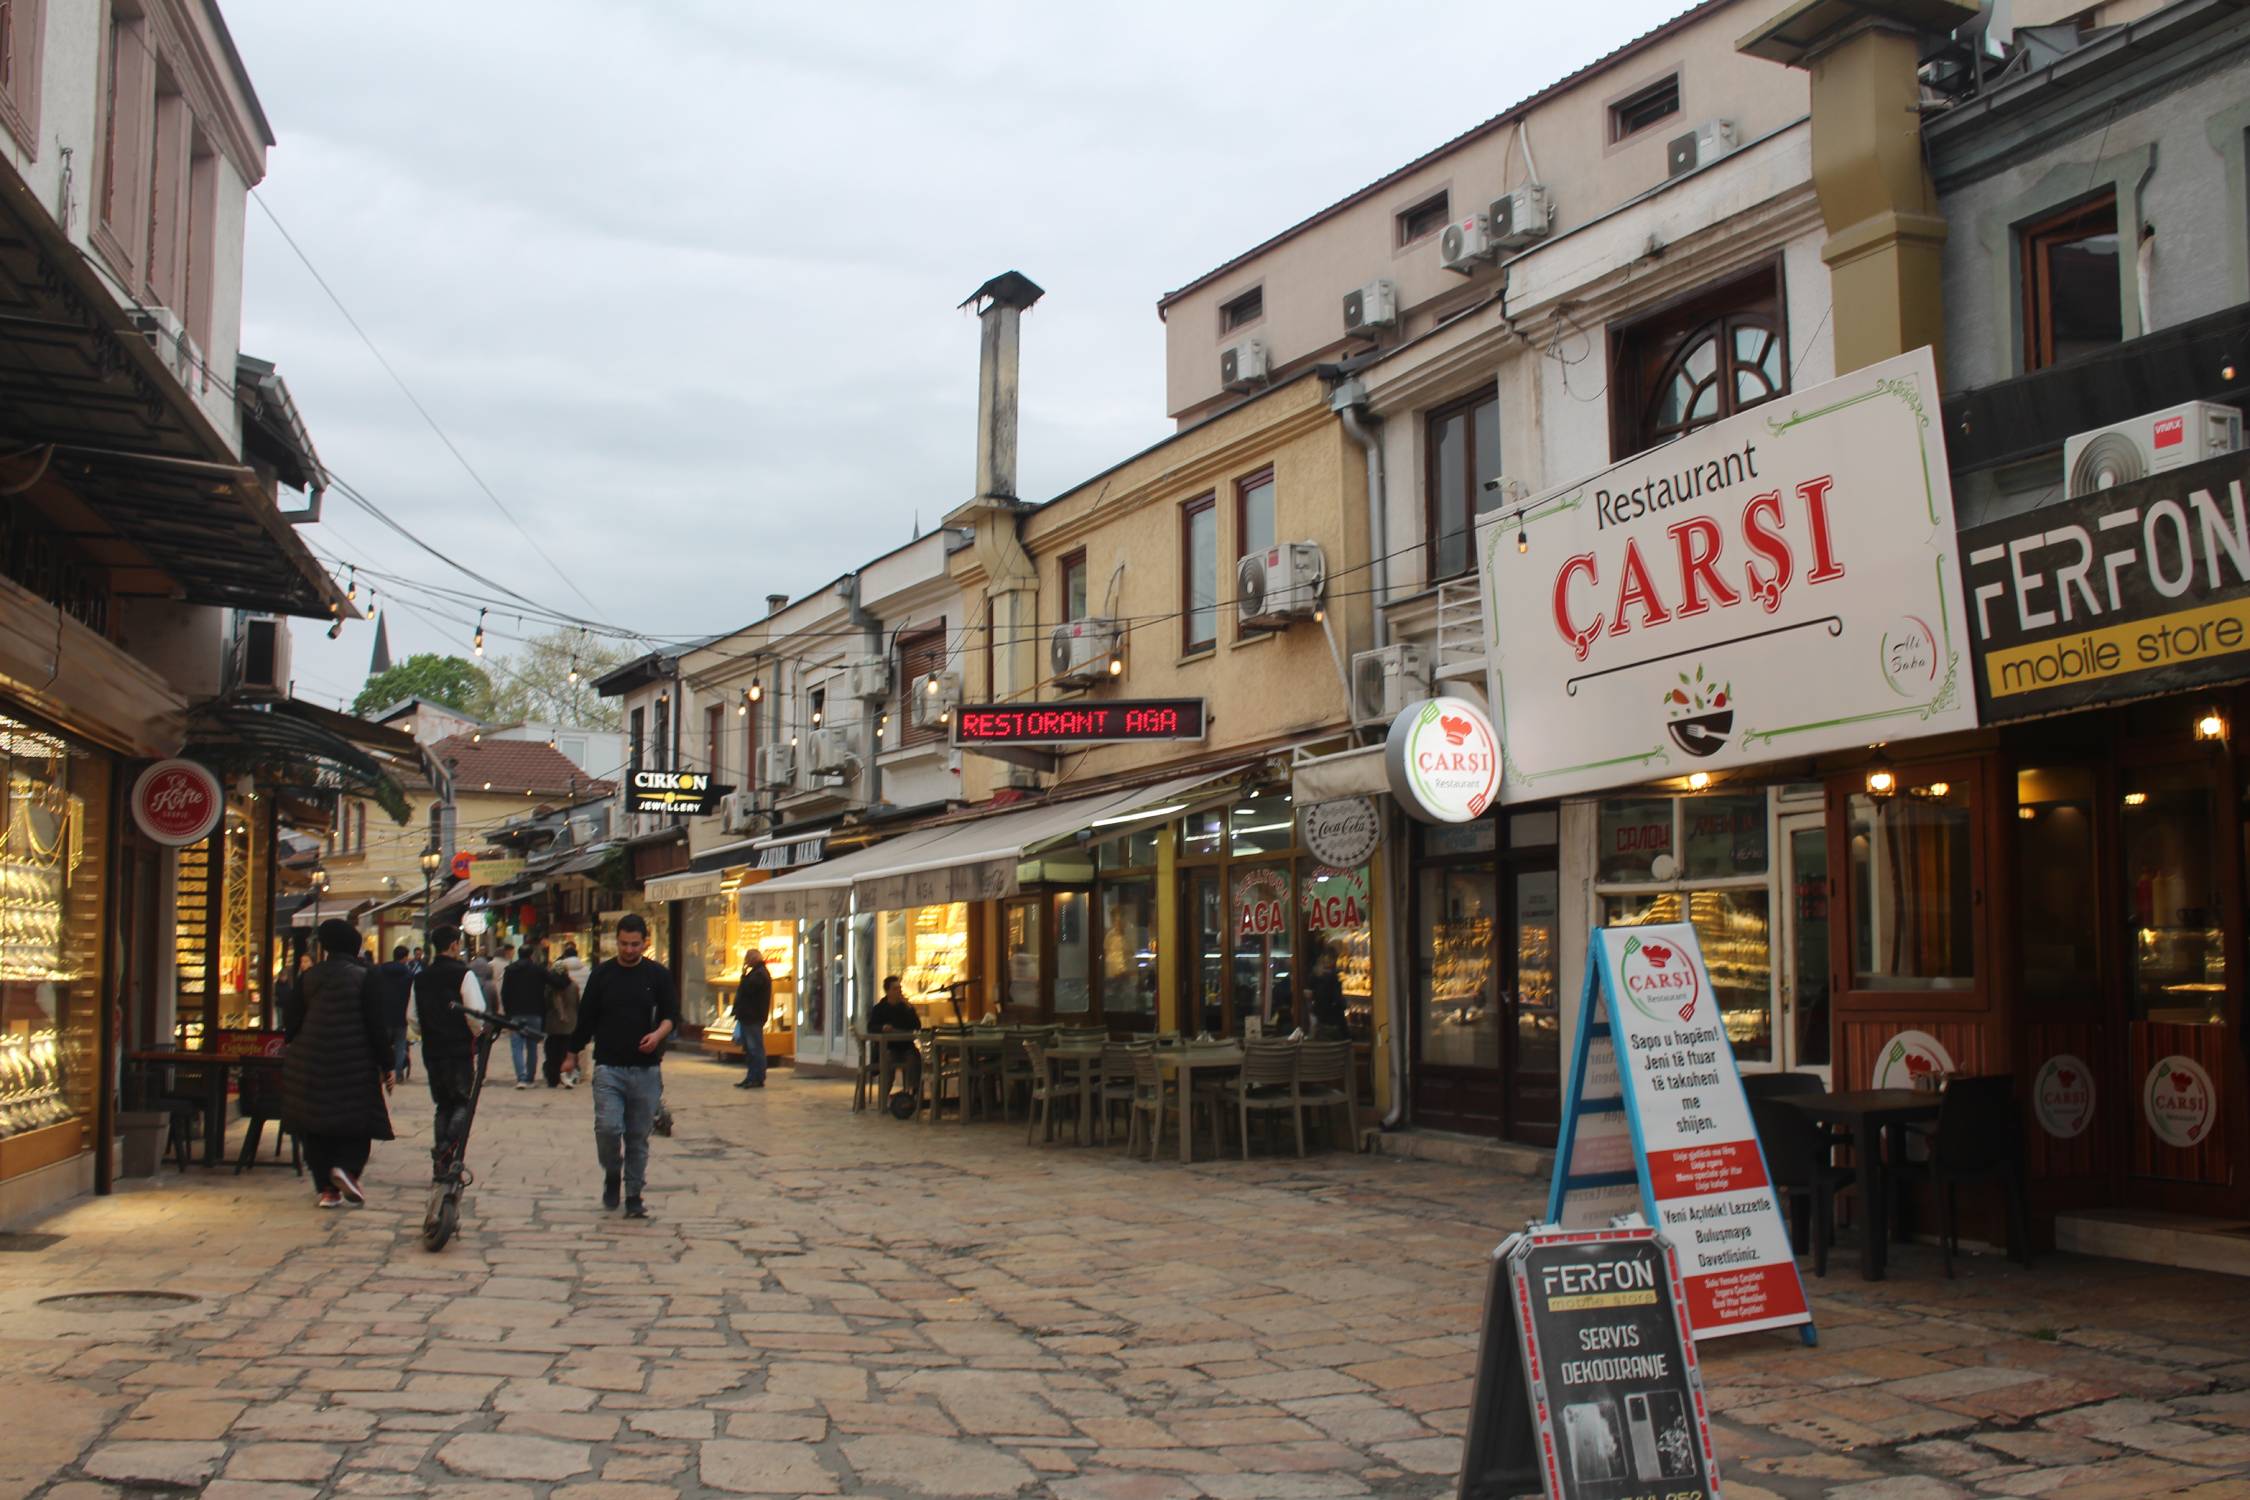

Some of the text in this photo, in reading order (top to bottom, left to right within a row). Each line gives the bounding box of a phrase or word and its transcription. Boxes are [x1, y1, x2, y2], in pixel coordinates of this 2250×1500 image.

[1595, 440, 1758, 530] Restaurant
[1552, 474, 1845, 661] ÇARŞI
[1970, 479, 2250, 640] FERFON
[2001, 616, 2244, 690] mobile store
[963, 709, 1178, 737] RESTORANT AGA
[1418, 752, 1489, 774] ÇARŞI
[634, 772, 708, 791] CIRKON
[1240, 900, 1286, 935] AGA
[1308, 896, 1361, 931] AGA
[1628, 971, 1693, 992] ÇARŞI
[1631, 1027, 1720, 1051] Sapo u hapëm!
[1644, 1049, 1716, 1070] Jeni të ftuar
[1652, 1070, 1720, 1091] të takoheni
[1682, 1097, 1701, 1110] me
[1676, 1114, 1718, 1135] shijen.
[1664, 1208, 1687, 1224] Yeni
[1729, 1198, 1771, 1216] Lezzetle
[1695, 1226, 1752, 1244] Buluşmaya
[1698, 1246, 1760, 1268] Davetlisiniz.
[1542, 1259, 1655, 1294] FERFON
[1551, 1293, 1655, 1310] mobile store
[1579, 1324, 1641, 1351] SERVIS
[1561, 1353, 1669, 1386] DEKODIRANJE
